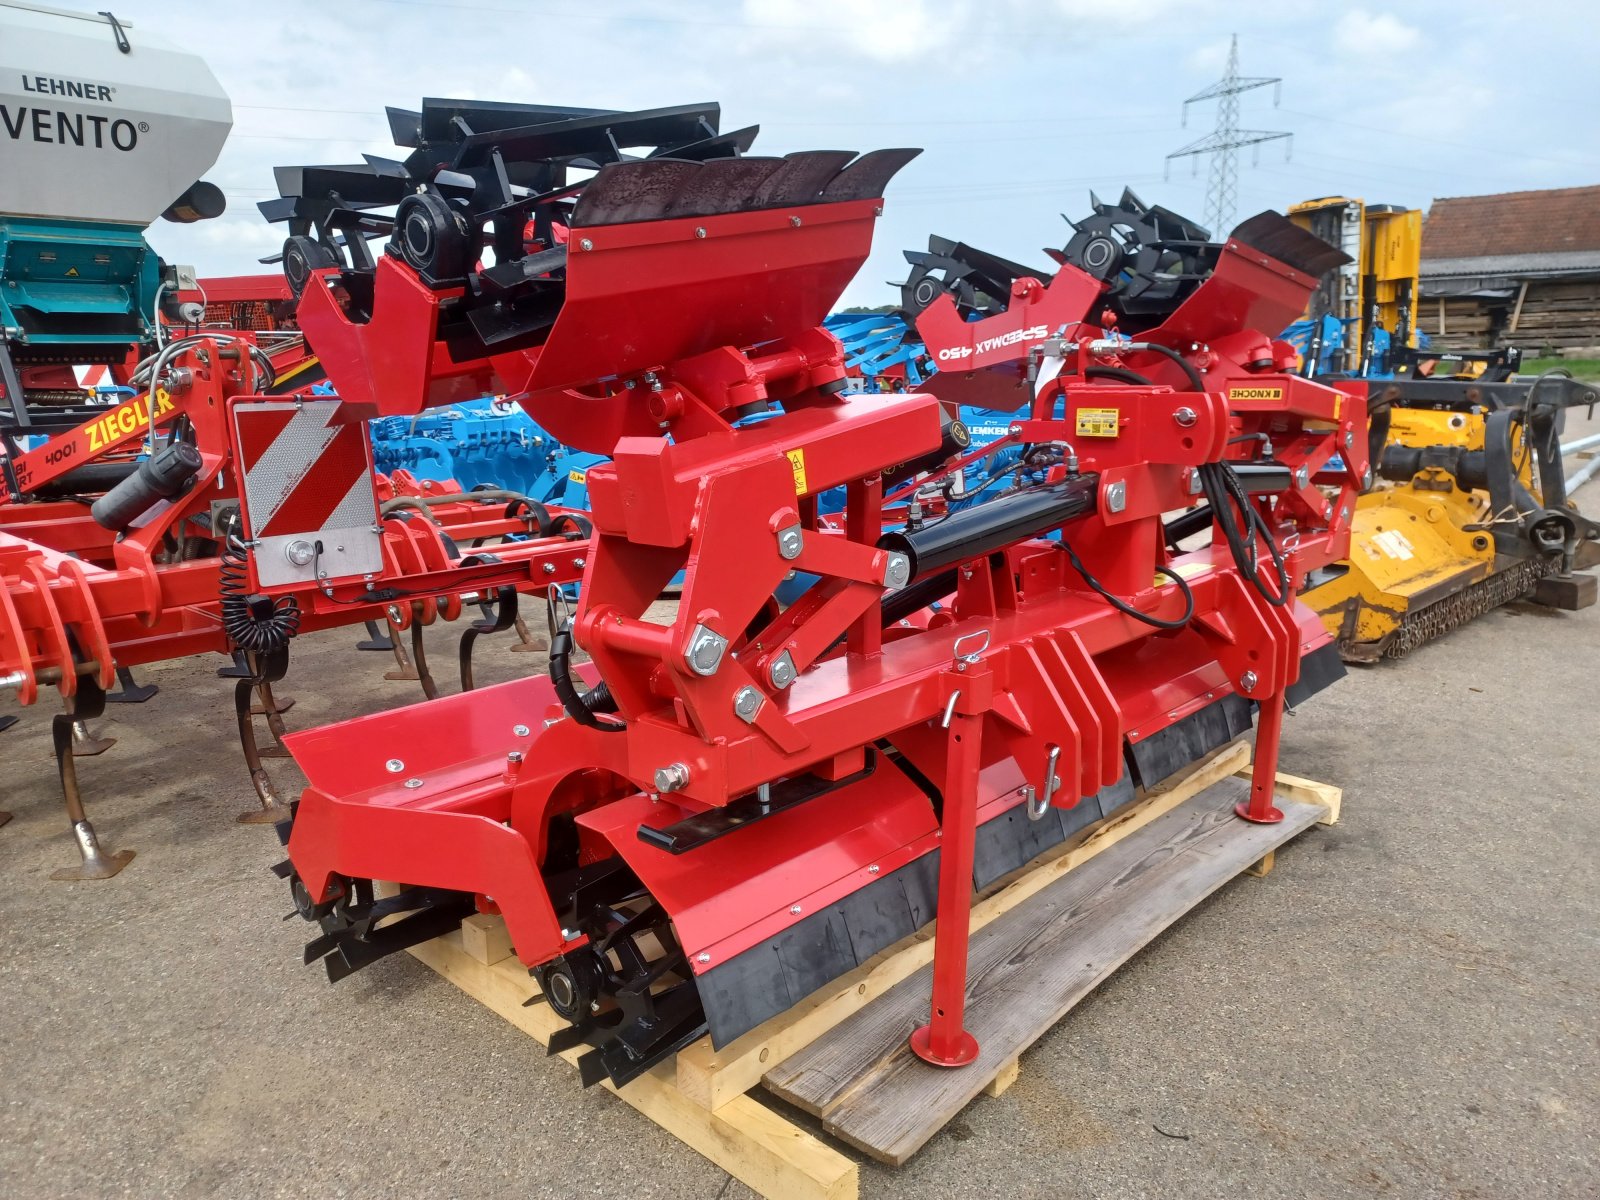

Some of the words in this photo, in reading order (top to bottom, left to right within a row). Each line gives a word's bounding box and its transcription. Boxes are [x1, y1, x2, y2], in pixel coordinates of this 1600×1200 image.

[976, 325, 1048, 354] SPEEDMAX
[939, 346, 972, 360] 450
[1231, 390, 1271, 398] KNOCHE
[968, 426, 1008, 435] LEMKEN
[45, 440, 77, 466] 4001
